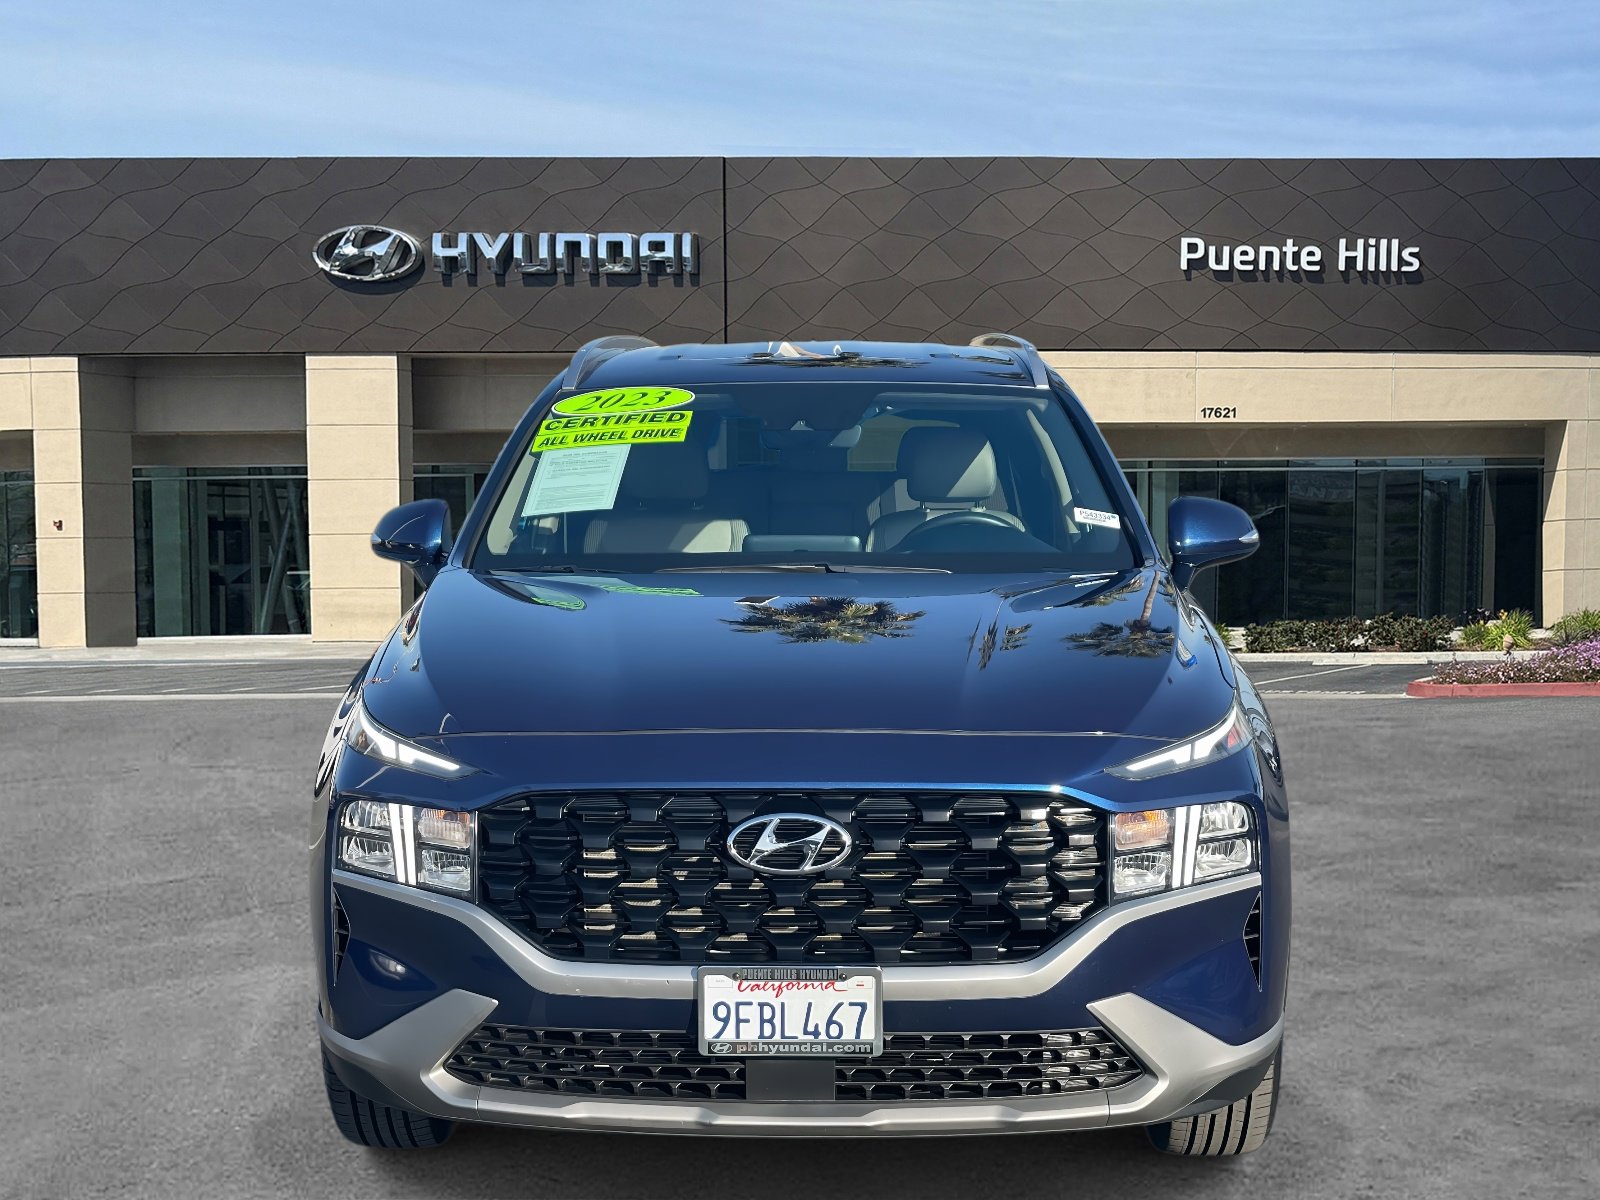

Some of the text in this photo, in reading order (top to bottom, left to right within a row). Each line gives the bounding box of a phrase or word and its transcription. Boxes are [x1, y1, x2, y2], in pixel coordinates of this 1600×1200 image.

[432, 231, 700, 275] HYUNDAI
[1180, 237, 1420, 272] Puente Hills
[574, 390, 673, 412] 2023
[544, 412, 687, 432] CERTIFIED
[1200, 407, 1237, 419] 17621
[538, 428, 684, 448] ALL WHEEL DRIVE
[742, 968, 838, 980] PUENTE HILLS HYUNDAI
[737, 979, 848, 998] California
[712, 1001, 868, 1039] 9FBL467
[736, 1042, 871, 1054] phhyundai.com
